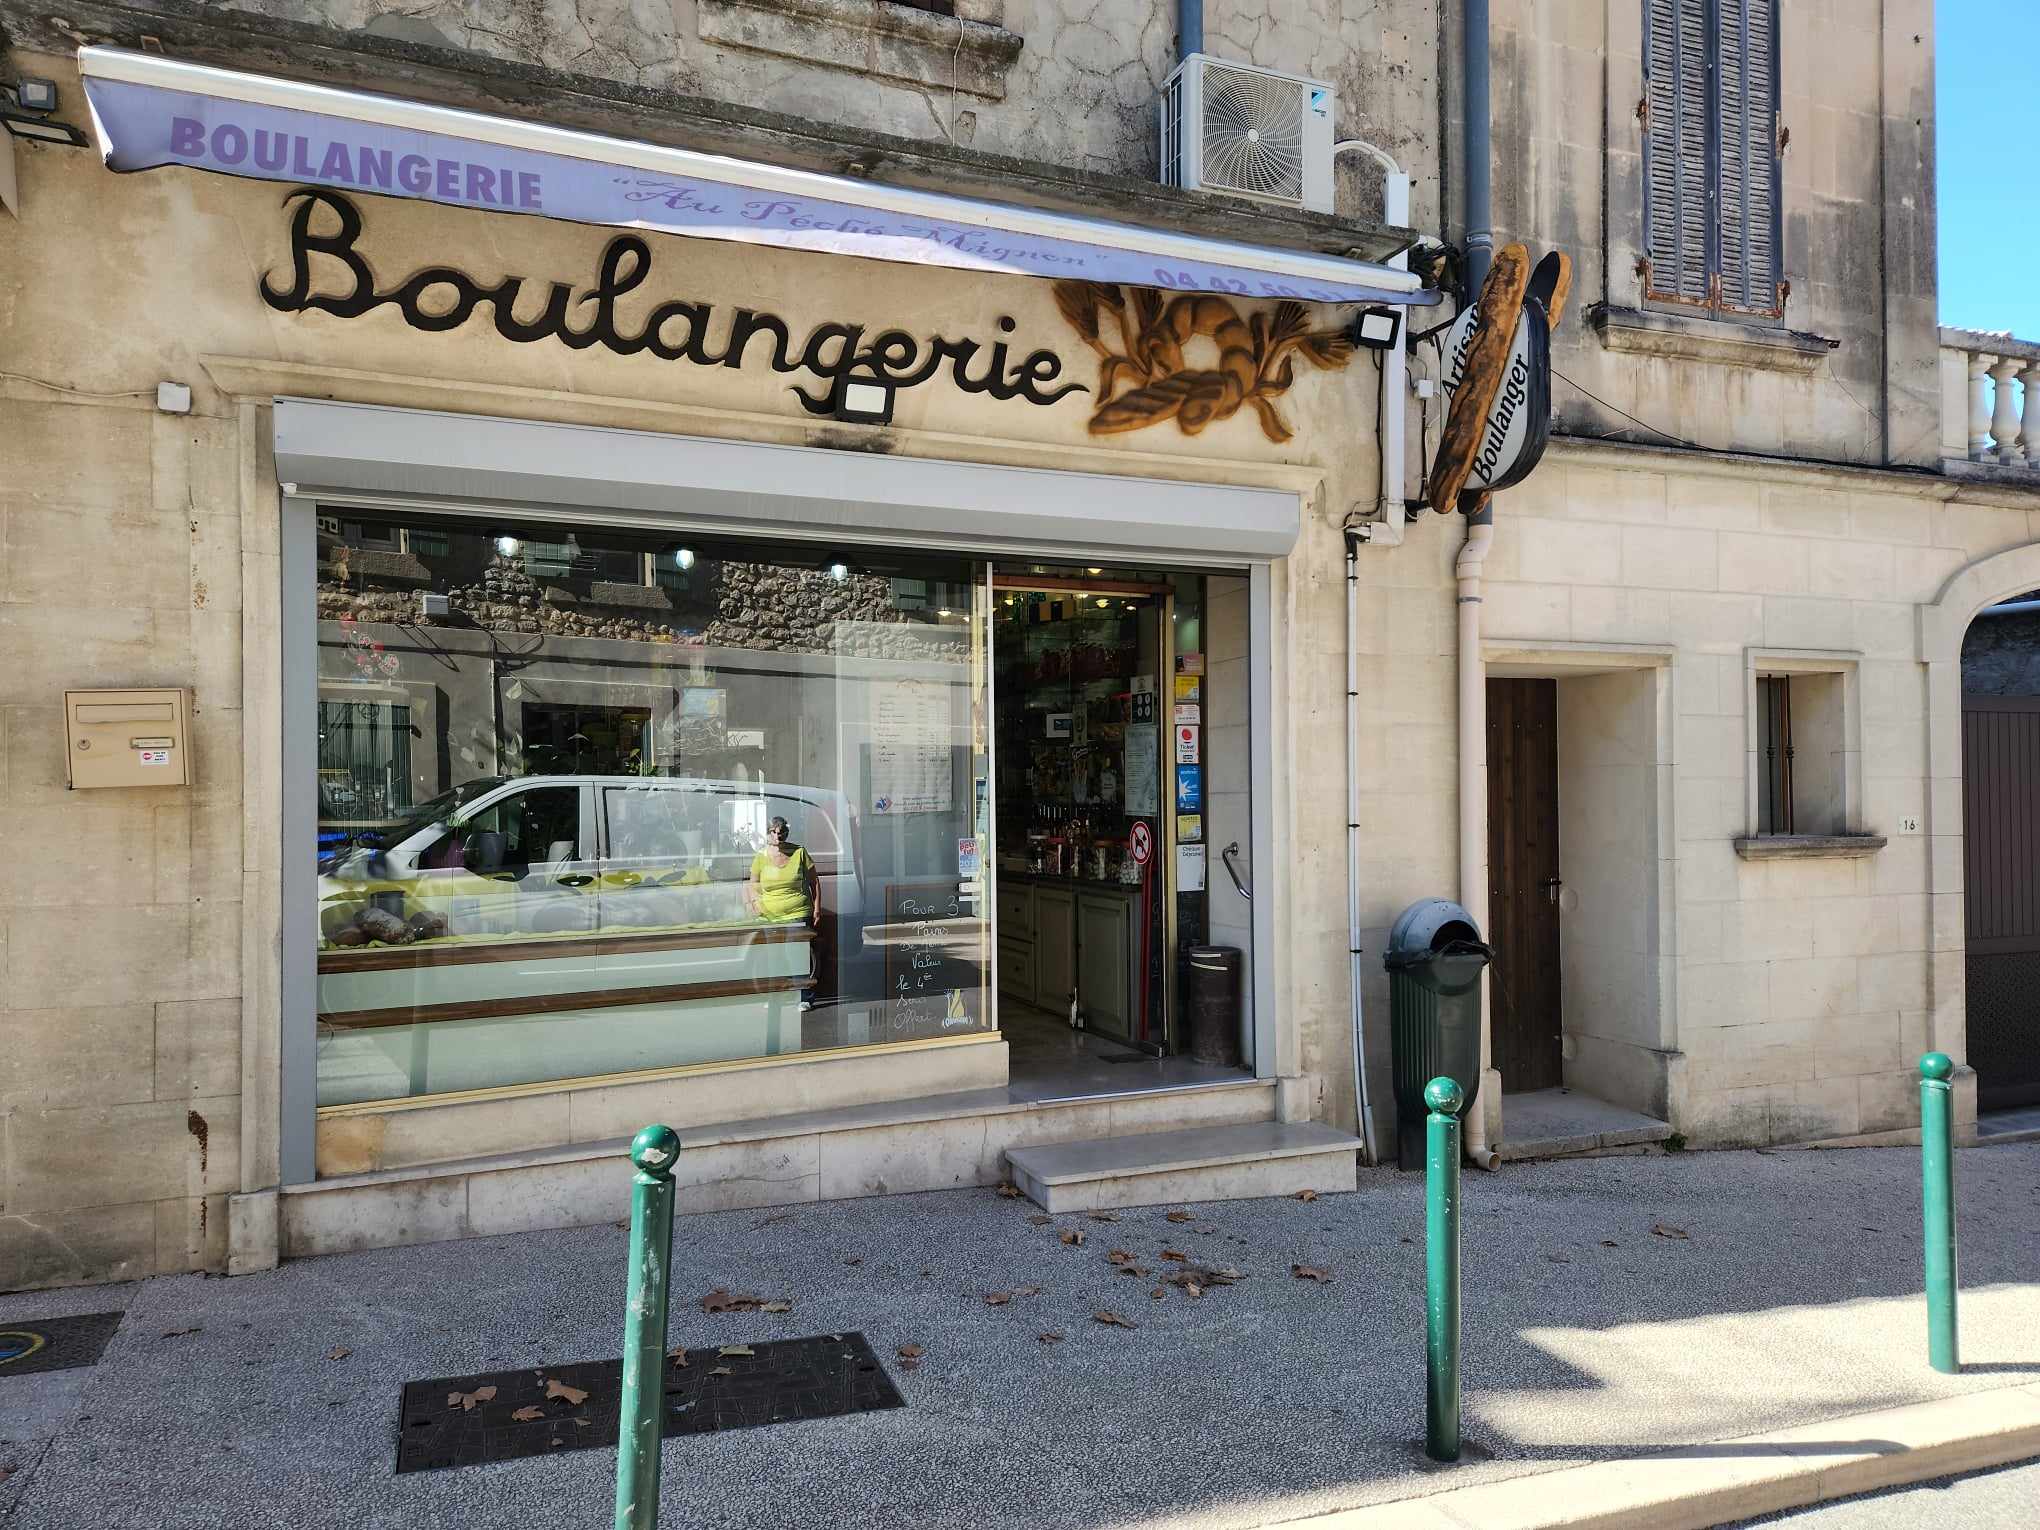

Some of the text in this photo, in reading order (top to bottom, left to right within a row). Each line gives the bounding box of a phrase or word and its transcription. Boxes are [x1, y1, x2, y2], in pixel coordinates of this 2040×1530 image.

[170, 116, 543, 209] BOULANGERIE
[260, 187, 1090, 413] Boulangerie
[1472, 353, 1530, 486] Boulanger
[1904, 820, 1916, 831] 16
[946, 895, 960, 917] 3
